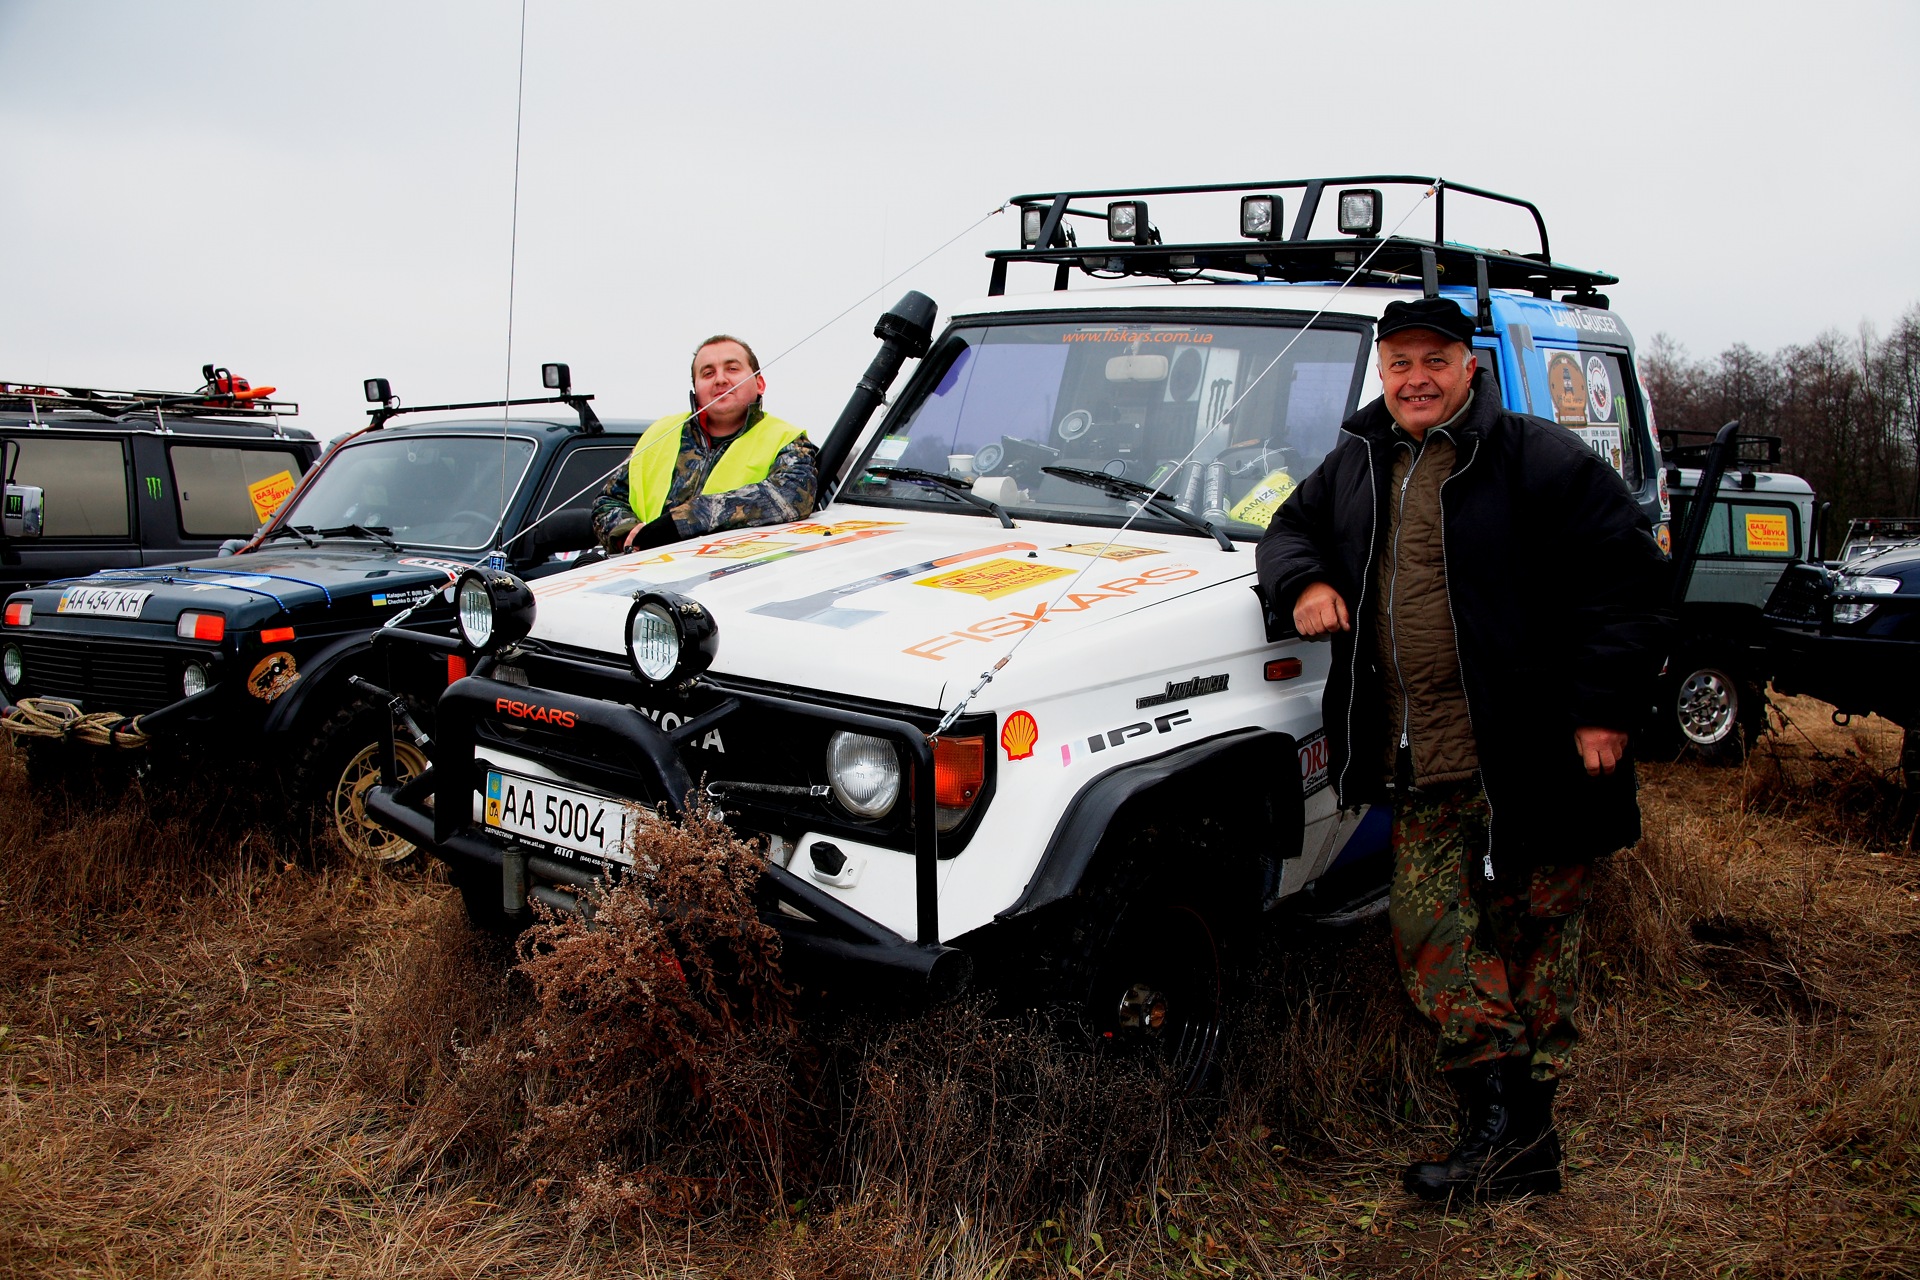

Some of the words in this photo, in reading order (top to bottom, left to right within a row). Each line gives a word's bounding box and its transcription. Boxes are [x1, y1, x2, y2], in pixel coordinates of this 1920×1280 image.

[1062, 329, 1214, 344] www.fiskars.com.ua
[66, 590, 88, 609] AA
[87, 591, 119, 610] 4347
[116, 592, 144, 613] KH
[905, 567, 1200, 661] FISKARS
[495, 698, 576, 729] FISKARS
[1086, 708, 1193, 754] IPF
[502, 784, 536, 831] AA
[543, 794, 606, 849] 5004
